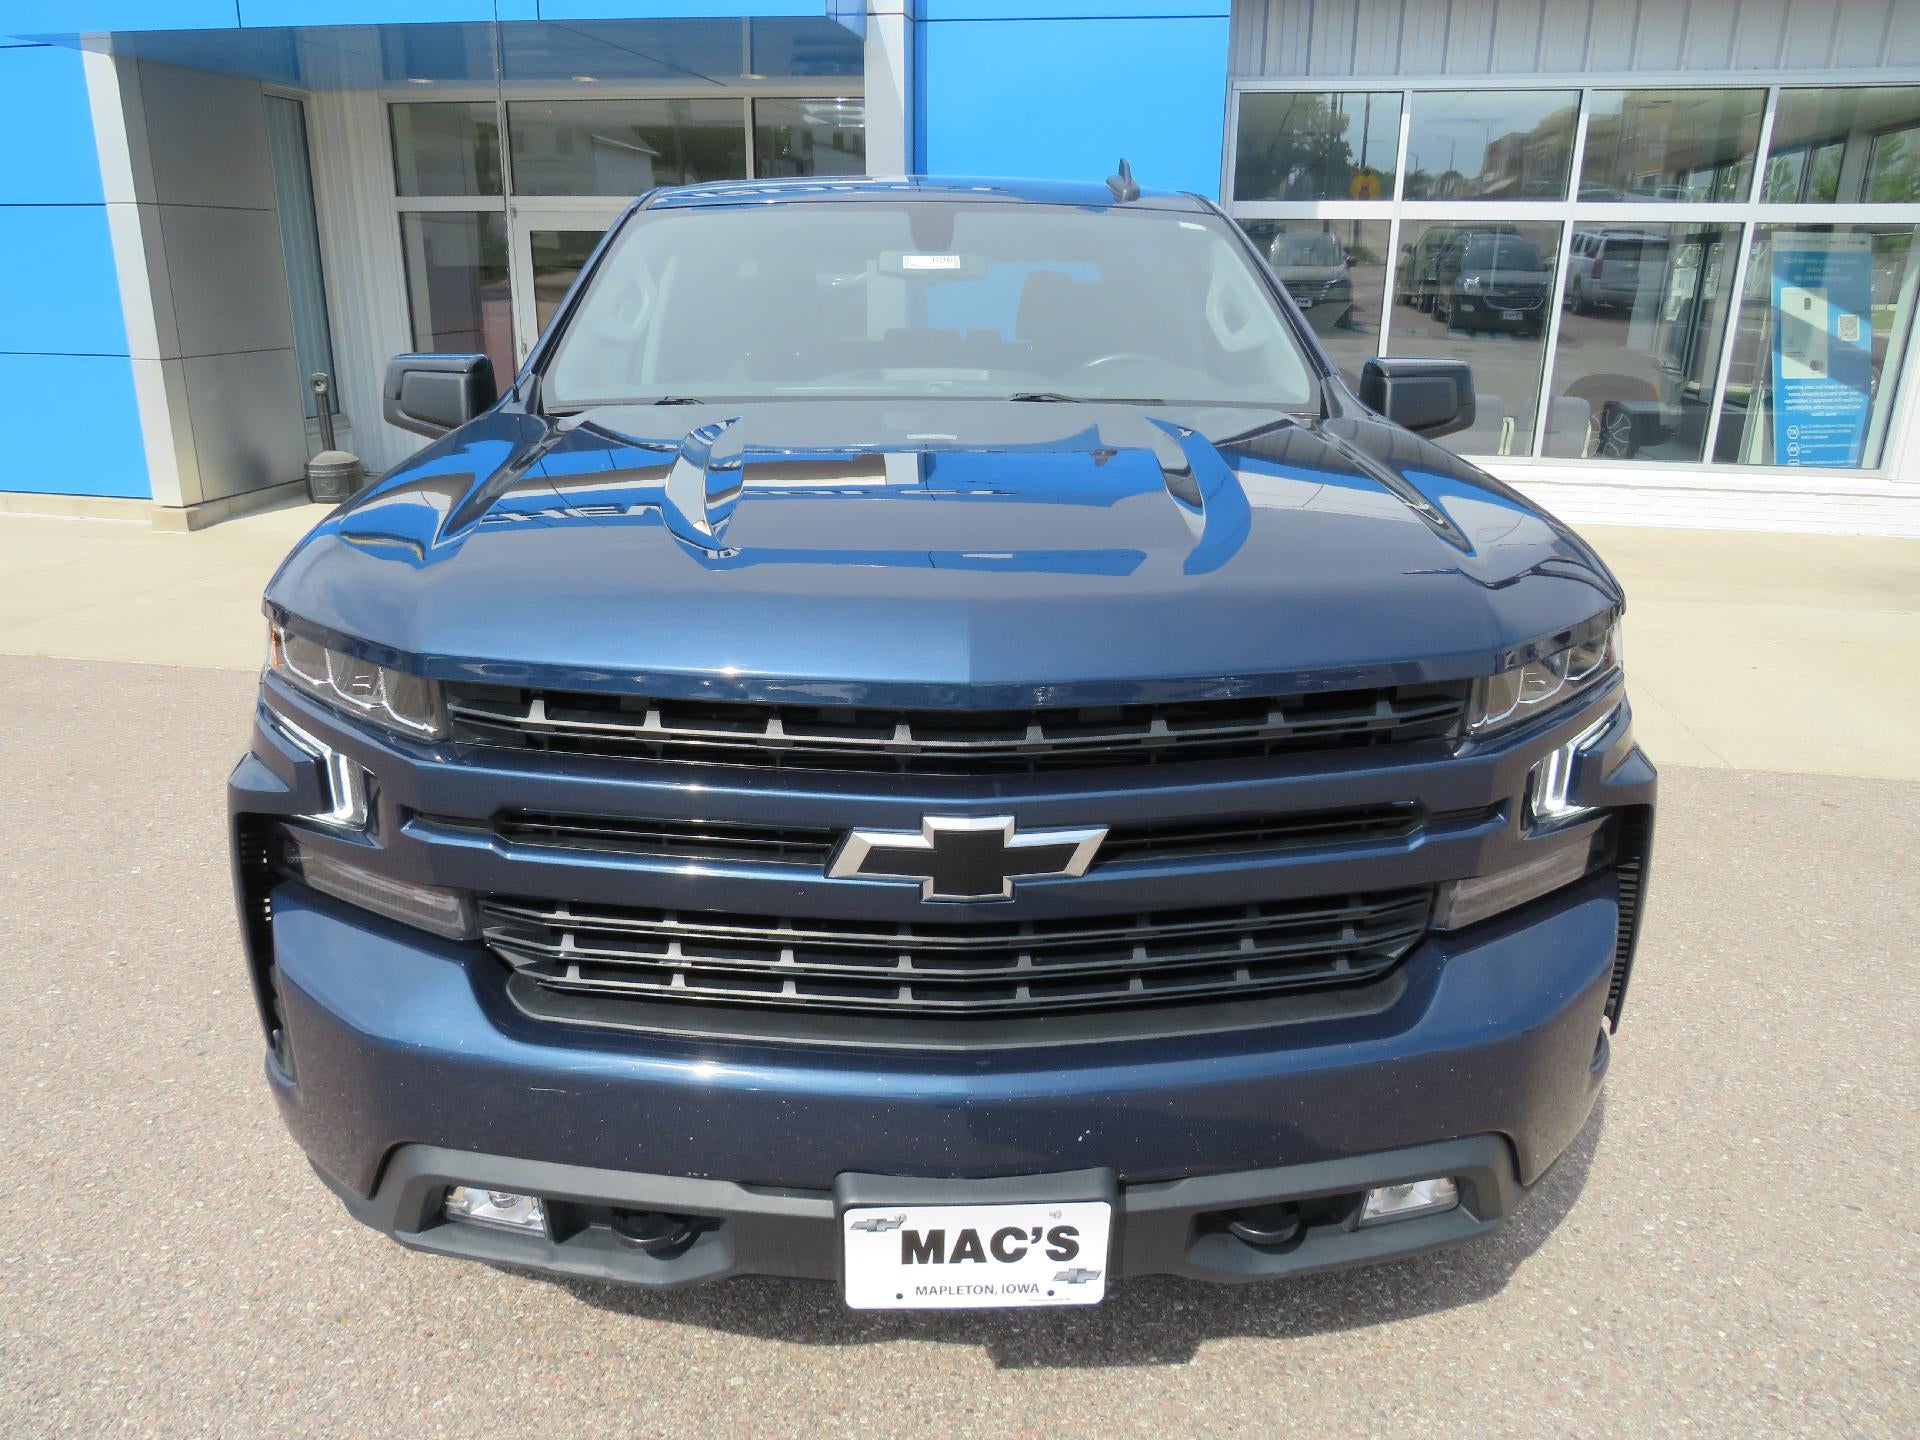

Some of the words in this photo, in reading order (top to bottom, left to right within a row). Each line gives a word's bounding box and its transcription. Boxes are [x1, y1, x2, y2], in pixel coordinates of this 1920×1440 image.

[901, 1225, 1080, 1265] MAC'S
[915, 1284, 998, 1297] MAPLETON,
[1001, 1283, 1040, 1294] IOWA
